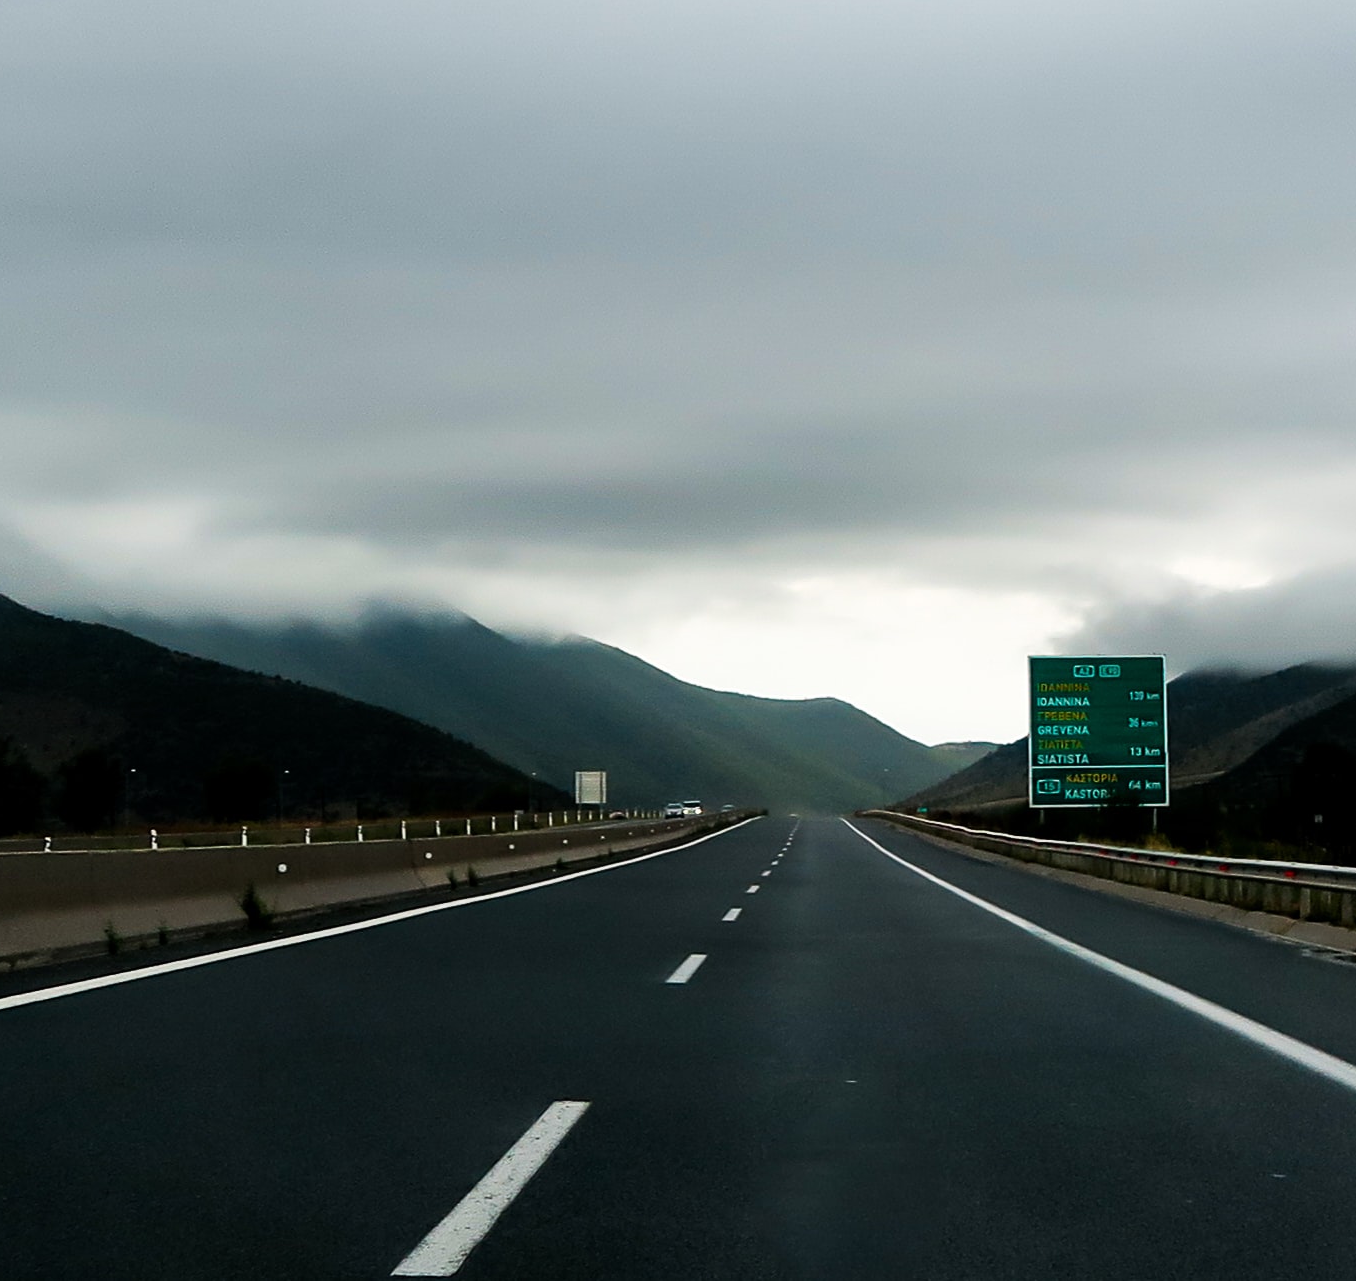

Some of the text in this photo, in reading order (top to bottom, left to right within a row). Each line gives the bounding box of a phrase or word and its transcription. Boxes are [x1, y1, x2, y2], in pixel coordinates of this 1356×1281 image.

[1146, 691, 1160, 700] km
[1037, 697, 1090, 706] IOANNINA
[1037, 725, 1090, 735] GREVENA
[1130, 747, 1160, 756] 13 km
[1037, 754, 1089, 764] SIATISTA
[1128, 780, 1161, 790] 64 km
[1065, 789, 1116, 799] KASTOR
